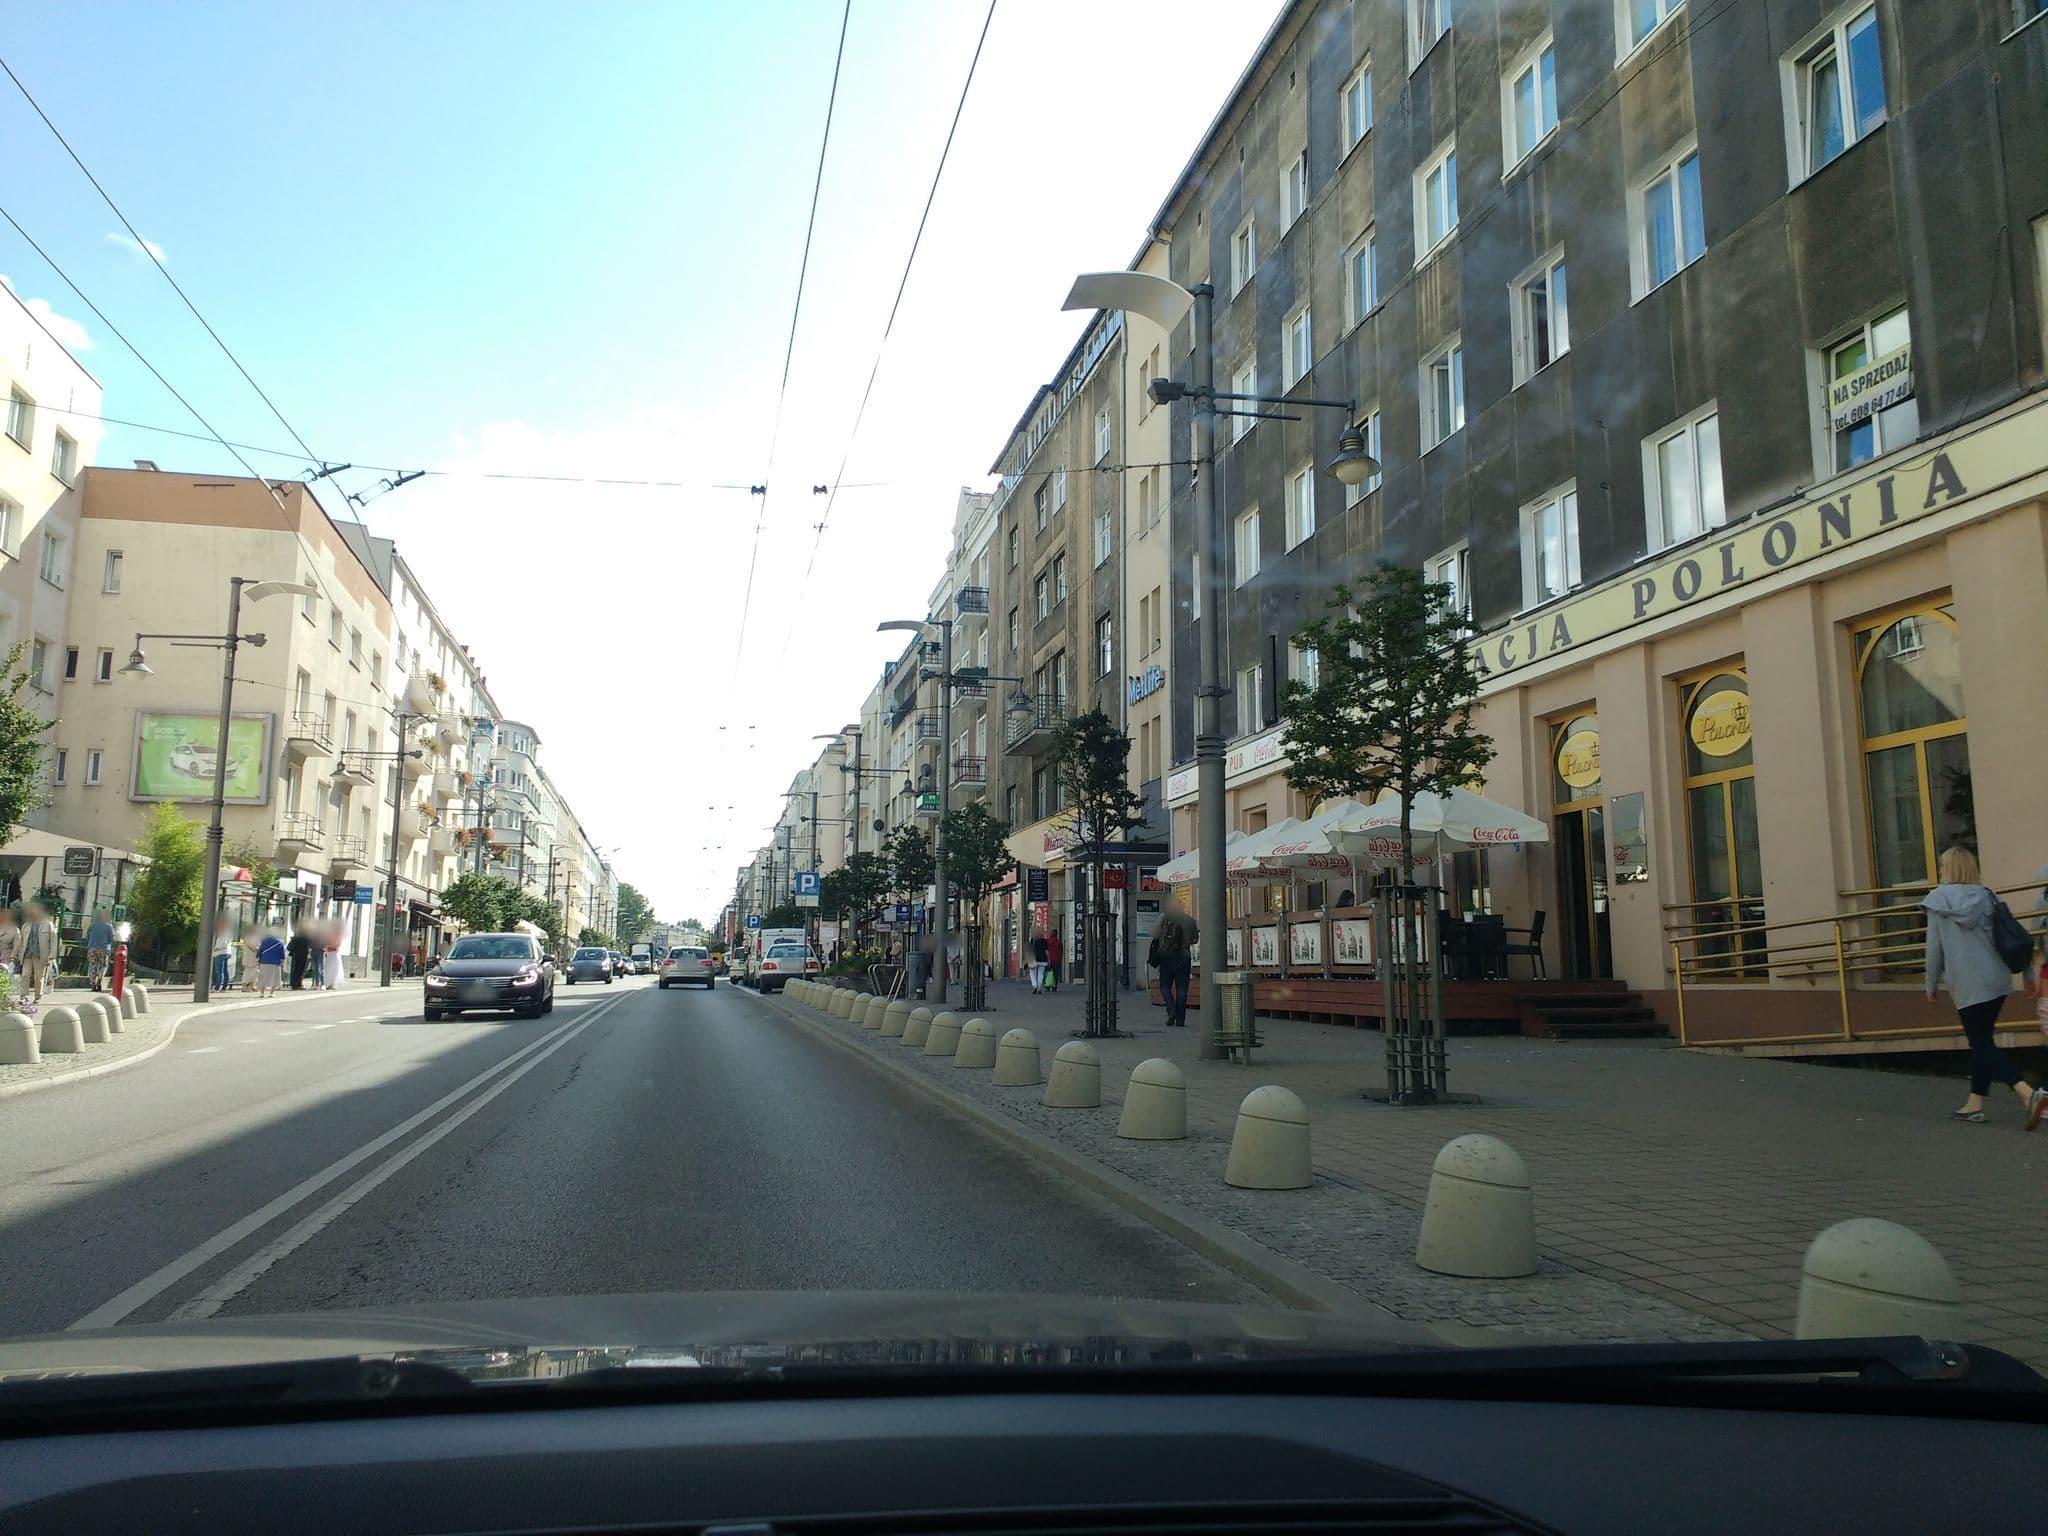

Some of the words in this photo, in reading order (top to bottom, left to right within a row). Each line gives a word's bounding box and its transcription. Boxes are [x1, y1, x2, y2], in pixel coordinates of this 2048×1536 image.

[1833, 384, 1849, 405] NA
[1851, 350, 1909, 397] SPRZEDAŻ
[1835, 413, 1850, 430] tel.
[1851, 402, 1869, 422] 608
[1871, 396, 1883, 412] 64
[1885, 389, 1894, 406] 77
[1632, 452, 1968, 620] POLONIA
[1229, 753, 1244, 772] PUB
[801, 874, 816, 893] P
[750, 916, 758, 927] P
[1075, 902, 1085, 961] GRAWER
